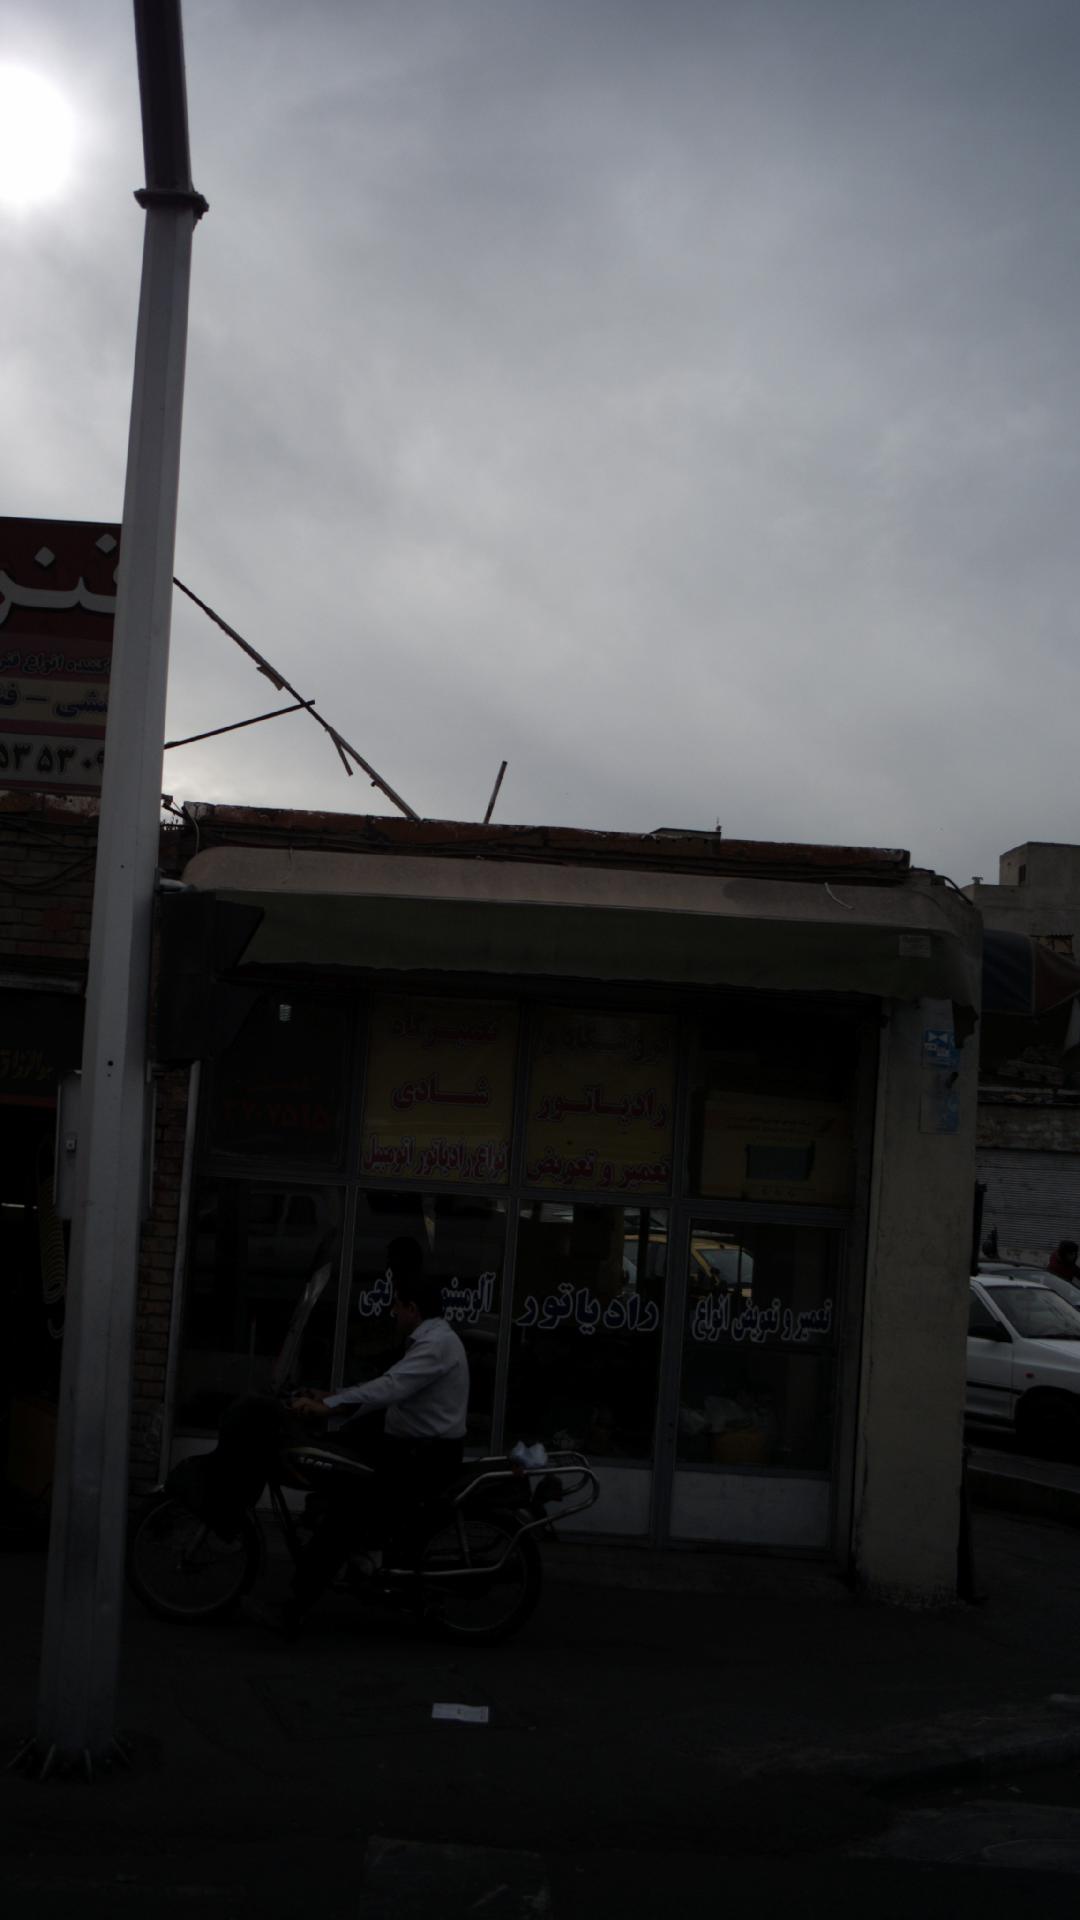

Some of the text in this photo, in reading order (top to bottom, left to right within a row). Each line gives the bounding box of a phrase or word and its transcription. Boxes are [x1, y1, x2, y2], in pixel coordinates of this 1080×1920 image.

[391, 1071, 490, 1113] شادی
[536, 1086, 668, 1134] رادیاتور
[692, 1294, 731, 1342] انواع
[731, 1297, 781, 1344] تعویض
[780, 1308, 794, 1341] و
[793, 1298, 833, 1342] تعمیر
